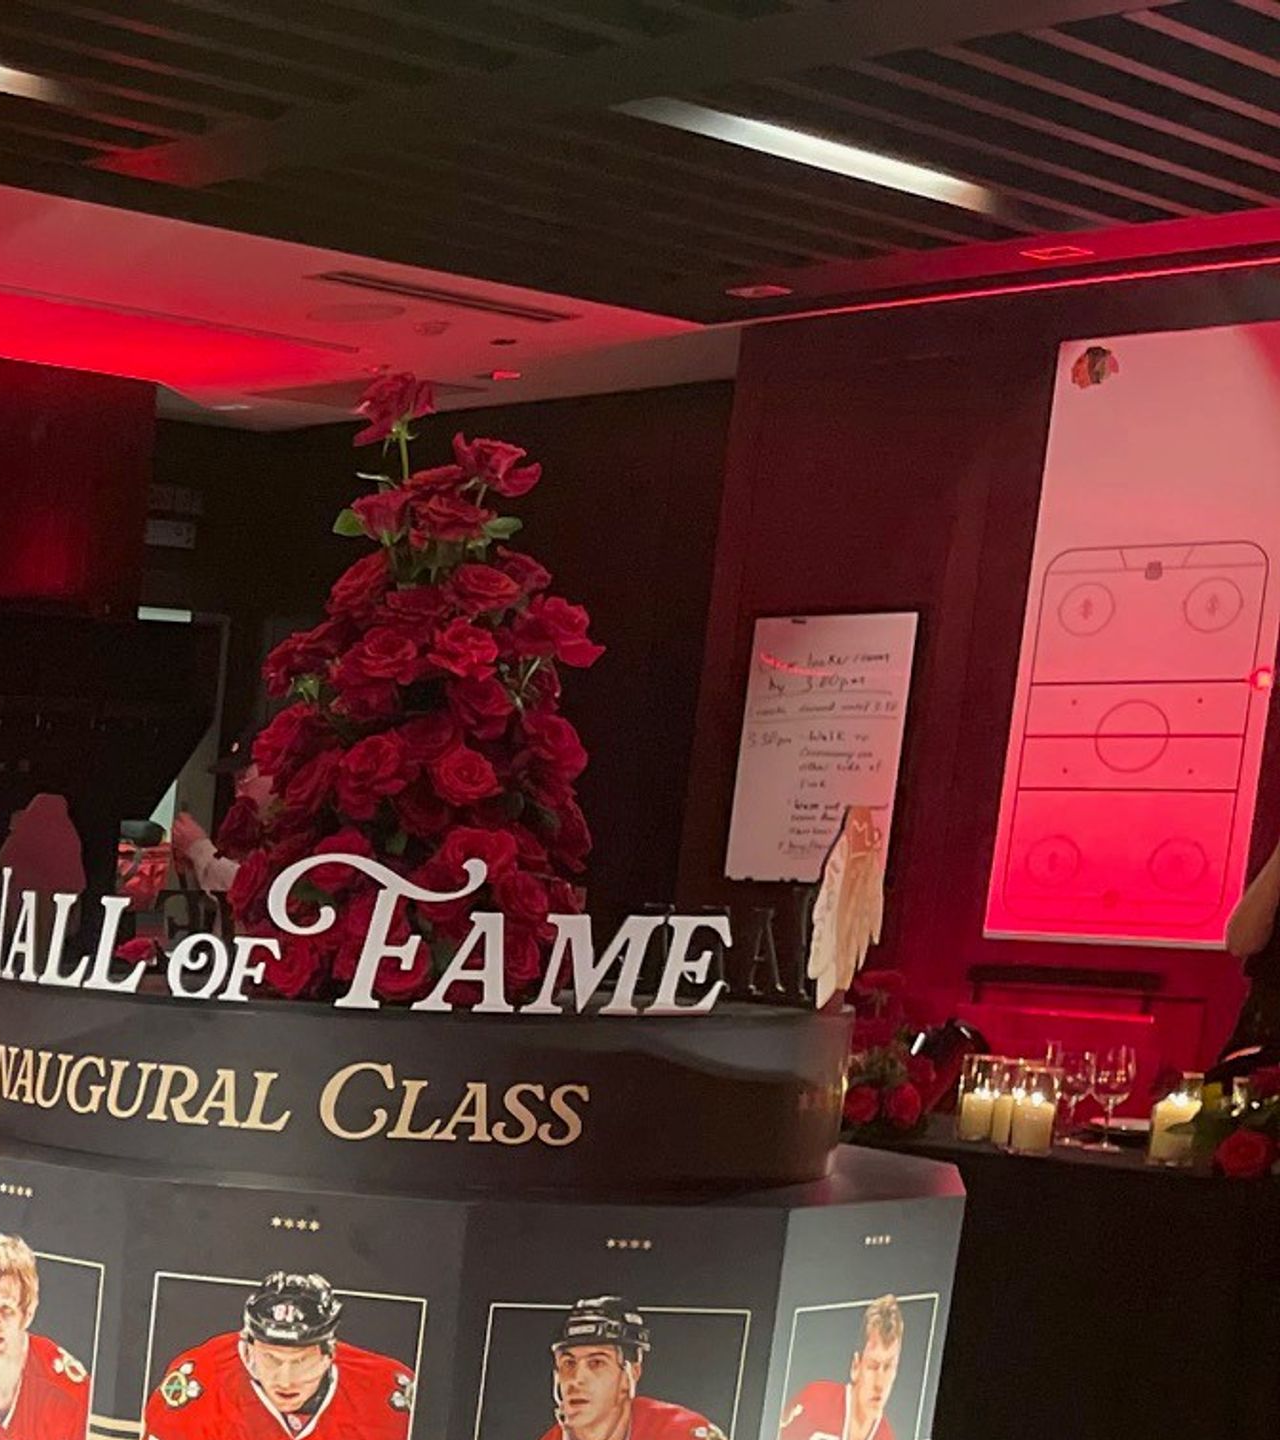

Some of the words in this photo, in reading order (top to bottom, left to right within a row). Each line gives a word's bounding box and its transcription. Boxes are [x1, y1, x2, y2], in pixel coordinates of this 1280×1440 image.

[167, 932, 283, 1002] OF
[266, 853, 734, 1016] FAME
[318, 1062, 591, 1147] CLASS
